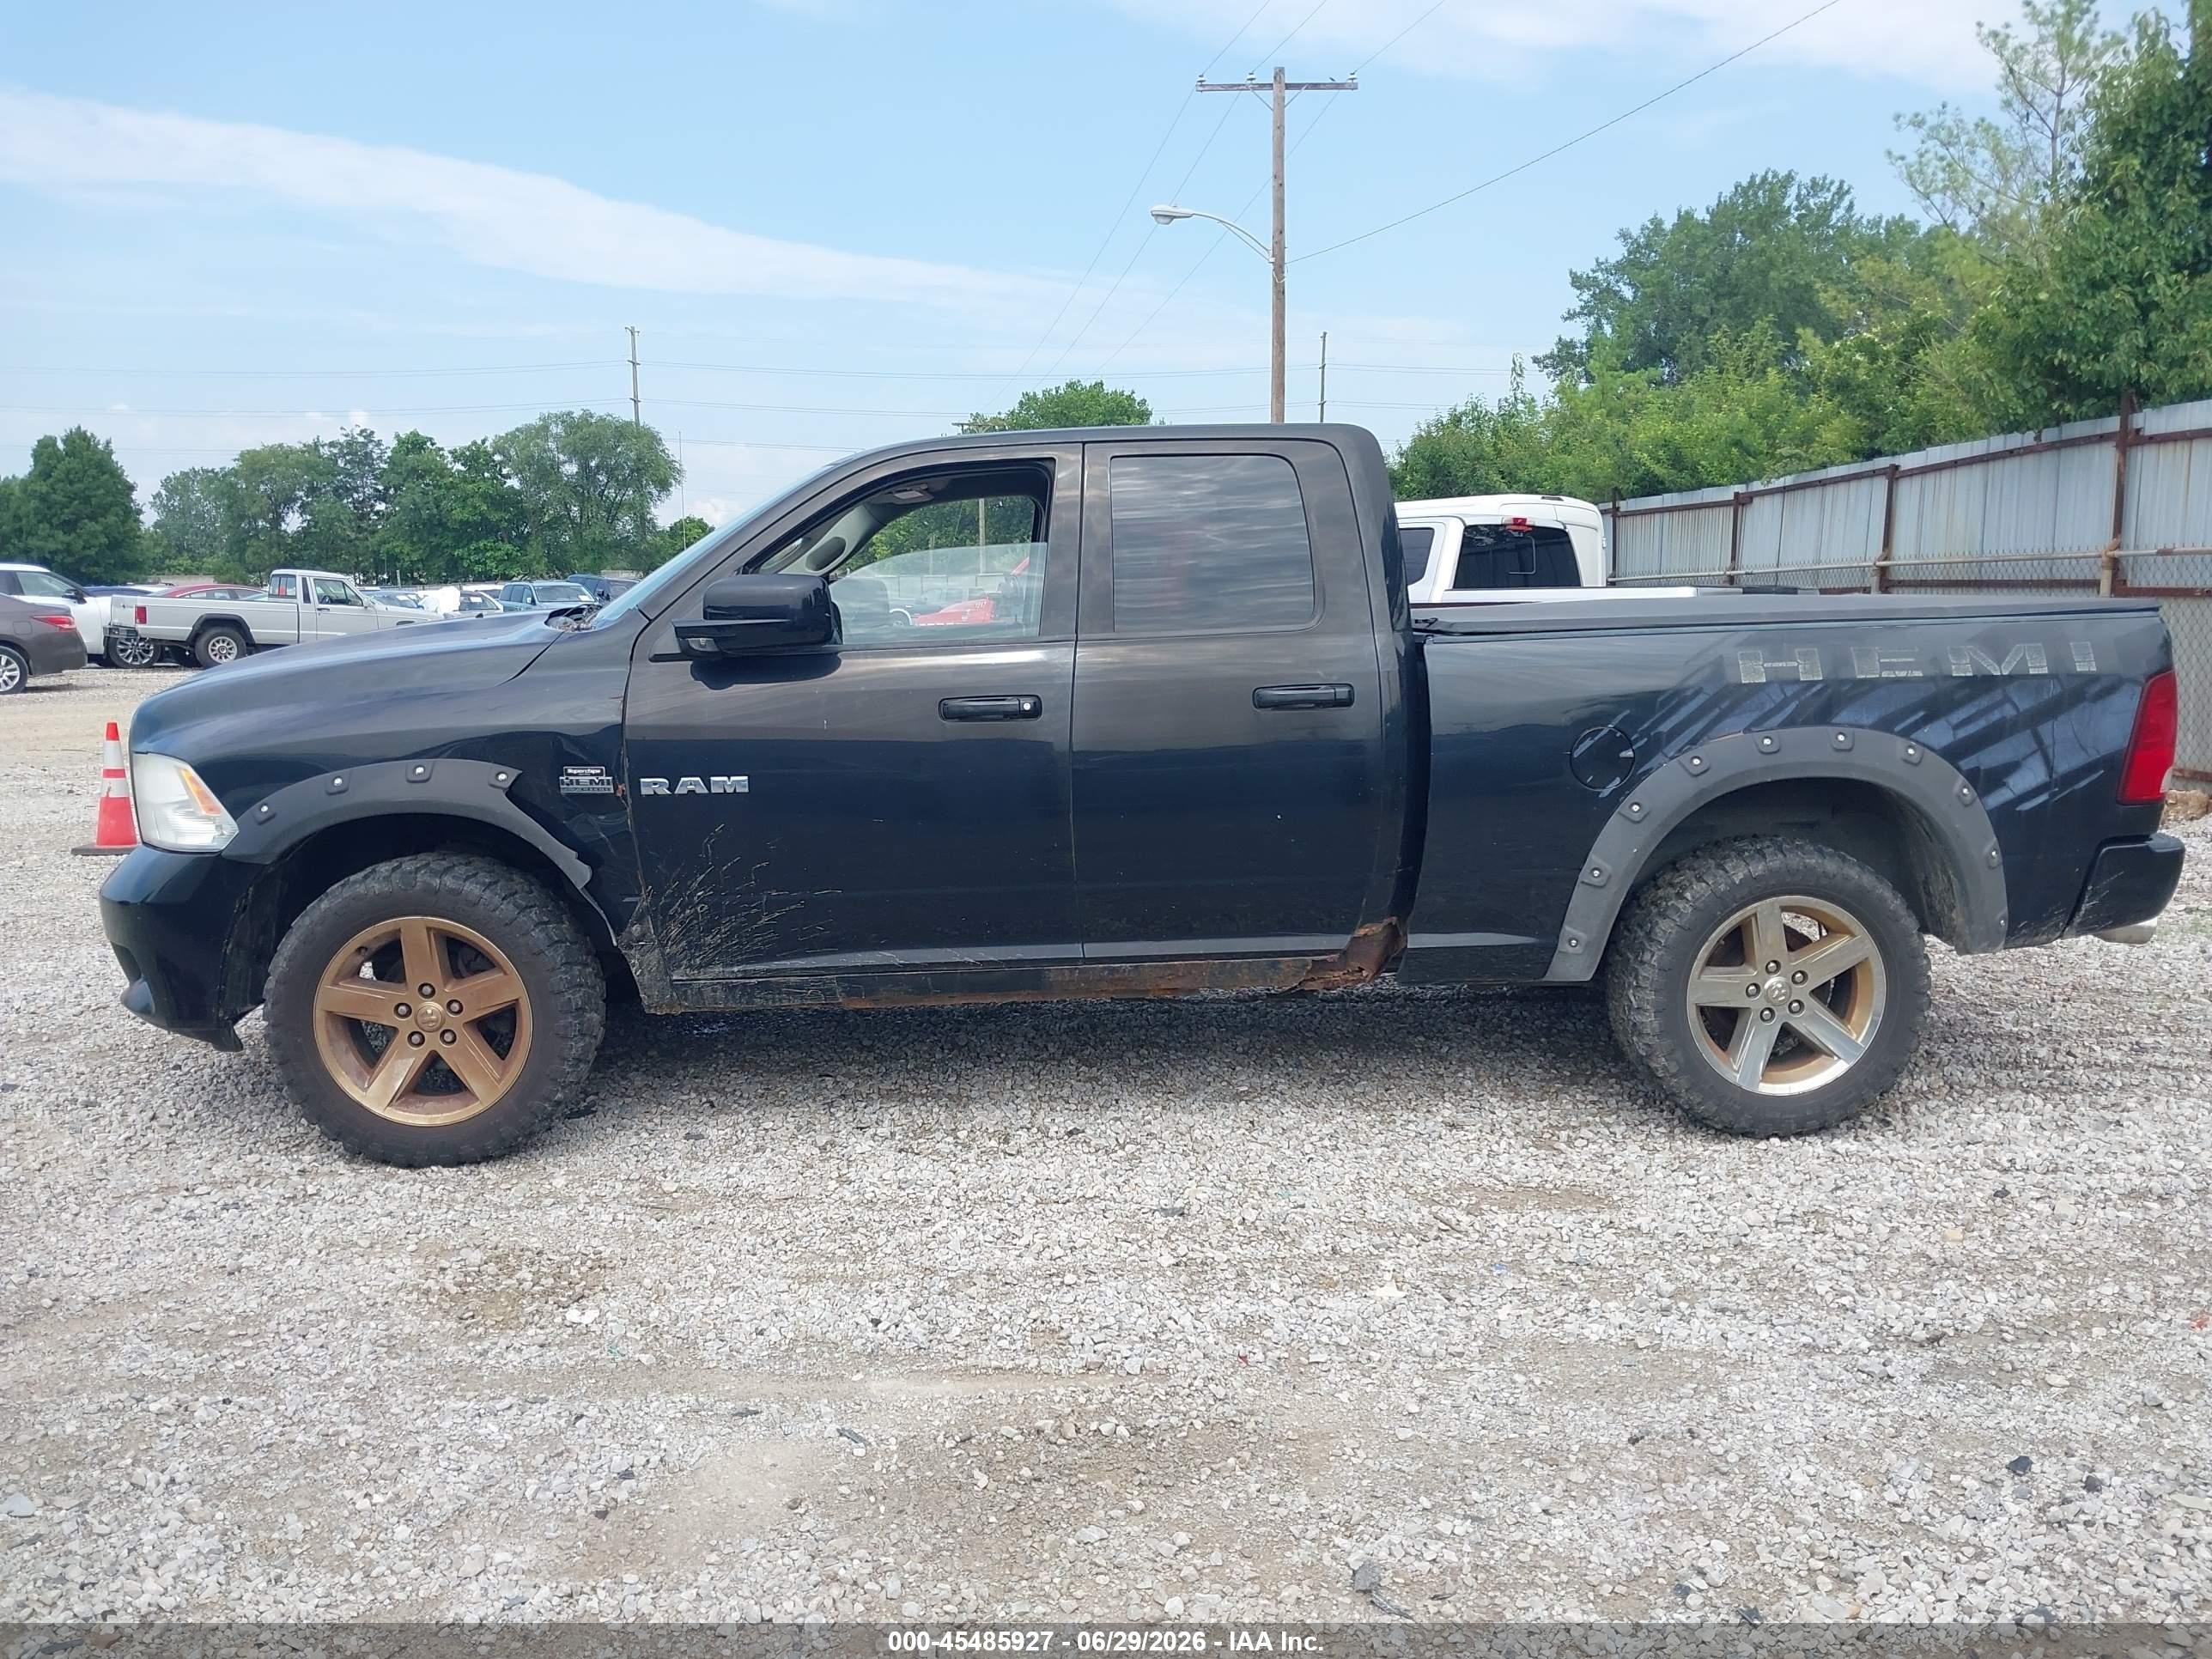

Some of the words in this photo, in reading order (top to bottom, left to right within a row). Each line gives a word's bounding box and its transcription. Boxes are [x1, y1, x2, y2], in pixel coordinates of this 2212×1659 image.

[1737, 641, 2097, 684] HEMI
[560, 777, 611, 786] HEMI
[640, 775, 750, 795] RAM
